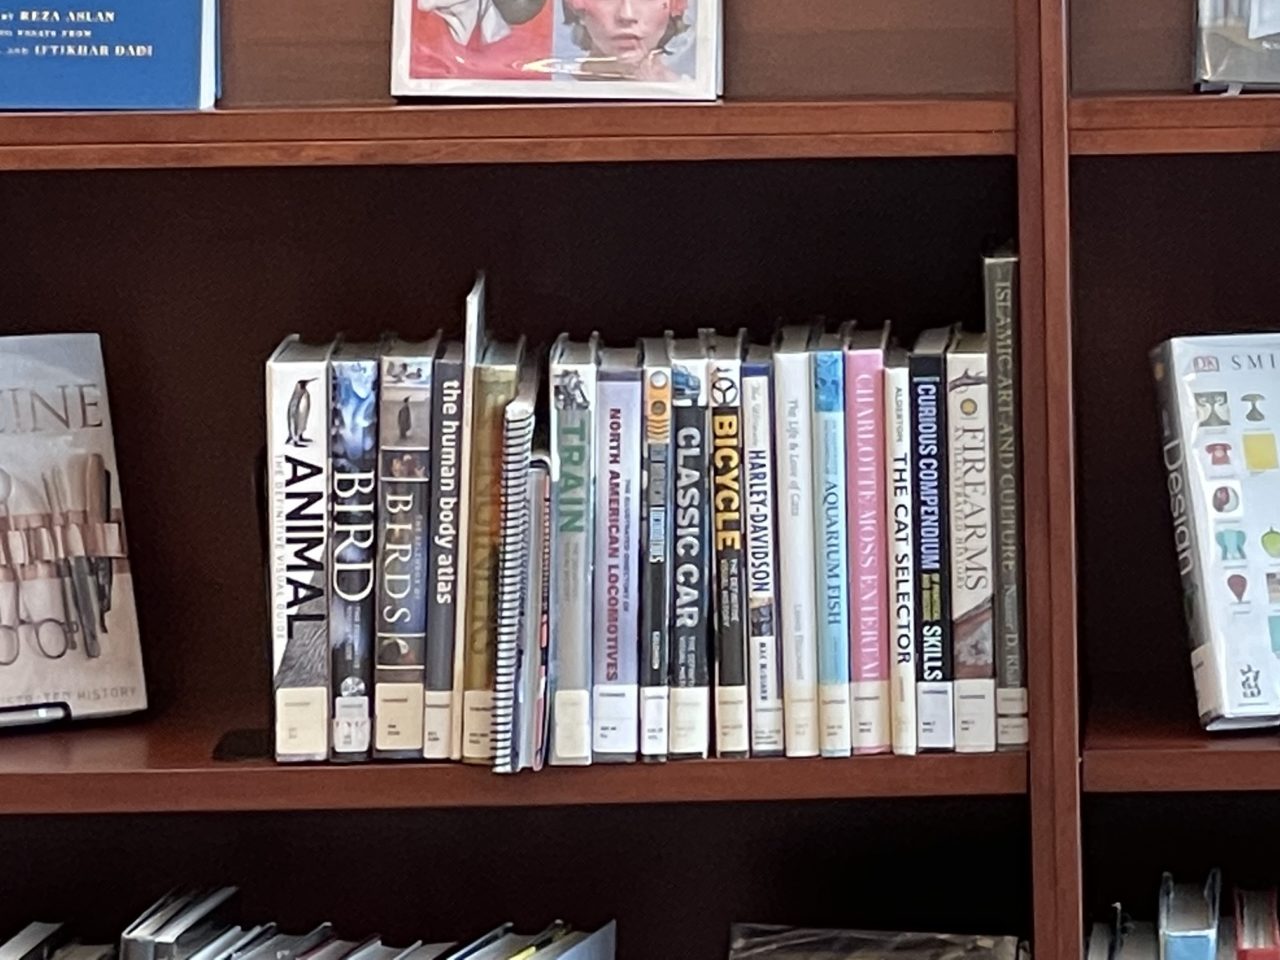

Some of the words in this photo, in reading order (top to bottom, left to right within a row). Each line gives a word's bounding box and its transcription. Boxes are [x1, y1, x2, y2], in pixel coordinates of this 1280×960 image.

[994, 280, 1014, 371] ISLAMIC
[441, 380, 459, 414] the
[608, 408, 621, 468] NORTH
[856, 374, 876, 502] CHARLOTTE
[918, 384, 937, 455] CURIOUS
[996, 375, 1015, 421] ART
[439, 420, 457, 491] human
[558, 419, 585, 532] TRAIN
[676, 426, 701, 557] CLASSIC
[713, 415, 741, 550] BICYCLE
[892, 452, 908, 498] THE
[998, 425, 1016, 467] AND
[285, 455, 324, 639] ANIMAL
[333, 470, 374, 602] BIRD
[432, 497, 455, 549] body
[607, 472, 621, 560] AMERICAN
[749, 450, 771, 592] HARLEY-DAVIDSON
[825, 480, 840, 580] AQUARIUM
[860, 511, 878, 568] MOSS
[894, 503, 909, 546] CAT
[920, 458, 940, 569] COMPENDIUM
[962, 426, 986, 591] FIREARMS
[1001, 473, 1018, 572] CULTURE
[1162, 442, 1195, 575] Design
[384, 492, 412, 624] BIRDS
[436, 555, 454, 604] atlas
[677, 563, 700, 628] CAR
[606, 564, 621, 681] LOCOMOTIVES
[828, 584, 842, 625] FISH
[862, 575, 881, 680] ENTERTAI
[894, 554, 912, 665] SELECTOR
[77, 687, 136, 701] HISTORY
[923, 625, 943, 681] SKILLS
